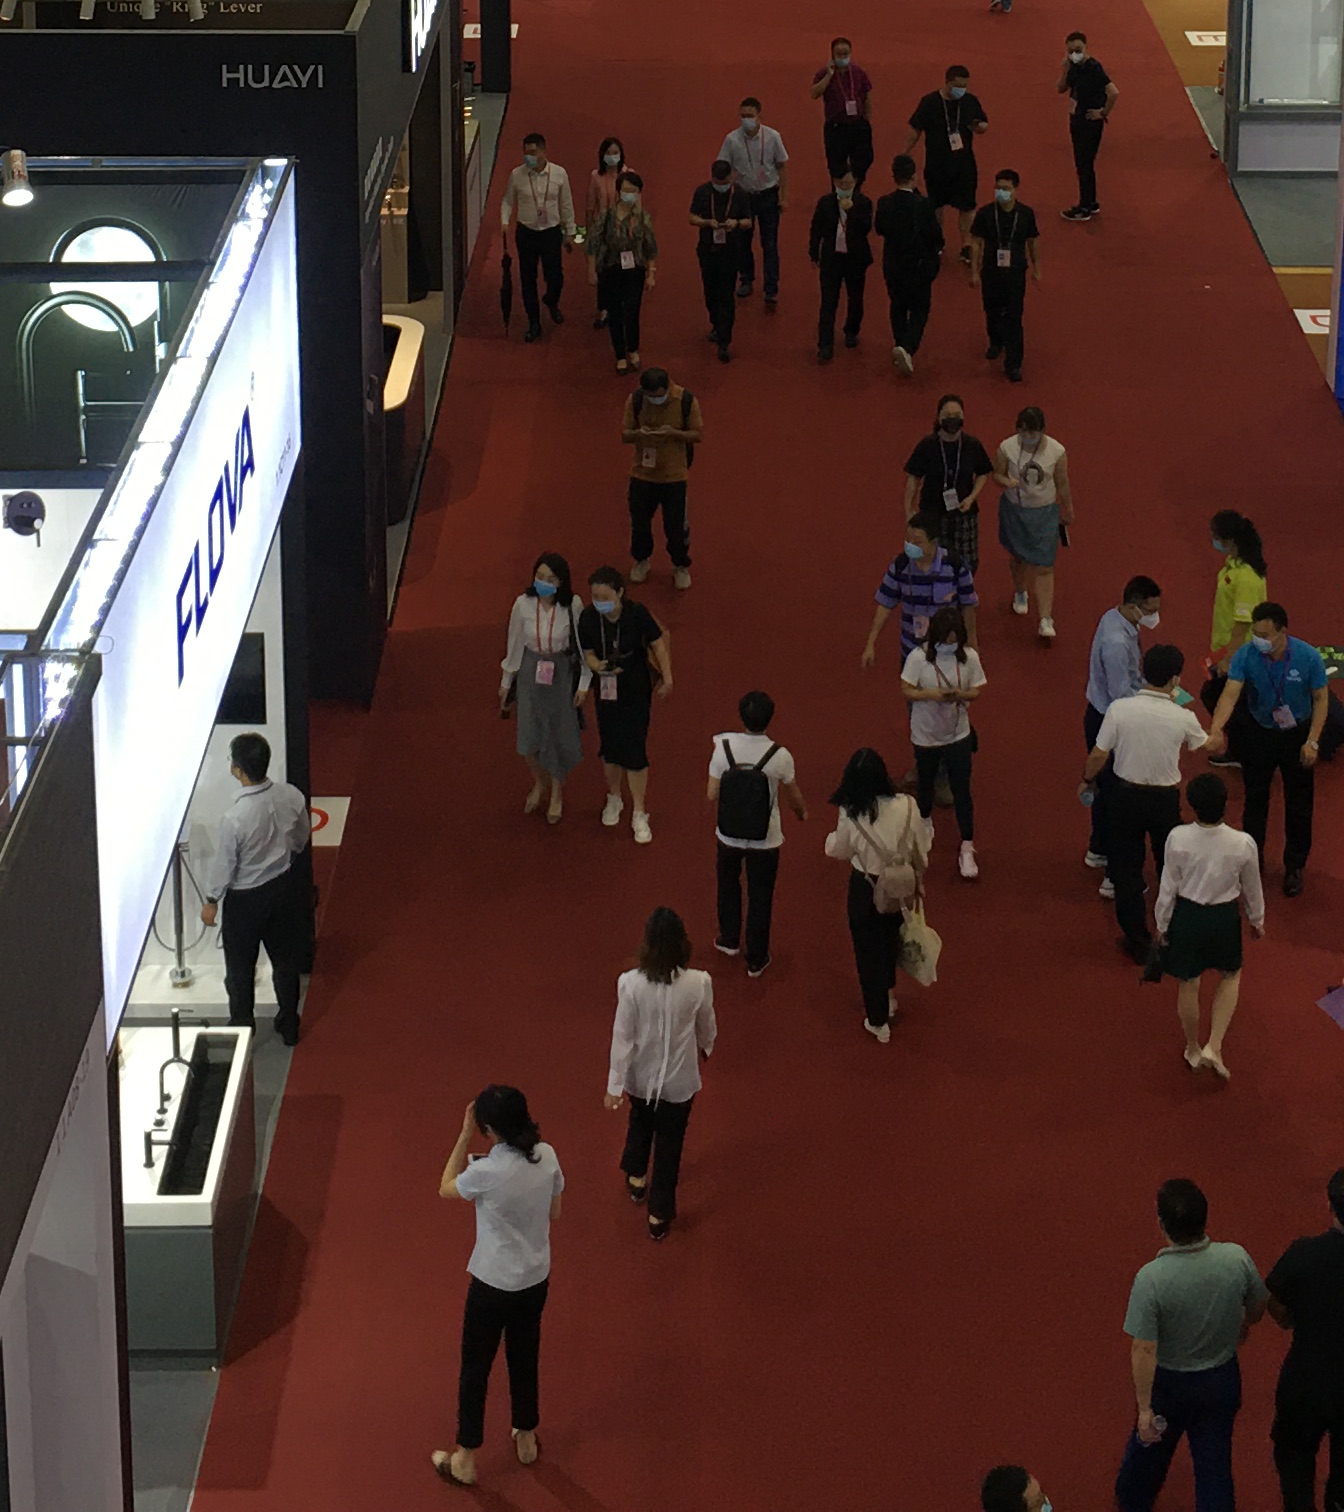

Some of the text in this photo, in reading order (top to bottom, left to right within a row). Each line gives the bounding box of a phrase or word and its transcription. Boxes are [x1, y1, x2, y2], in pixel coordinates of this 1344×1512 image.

[106, 1, 160, 17] Uniqe
[219, 0, 264, 15] Lever
[221, 63, 324, 89] HUAYI
[176, 404, 255, 690] FLOVA
